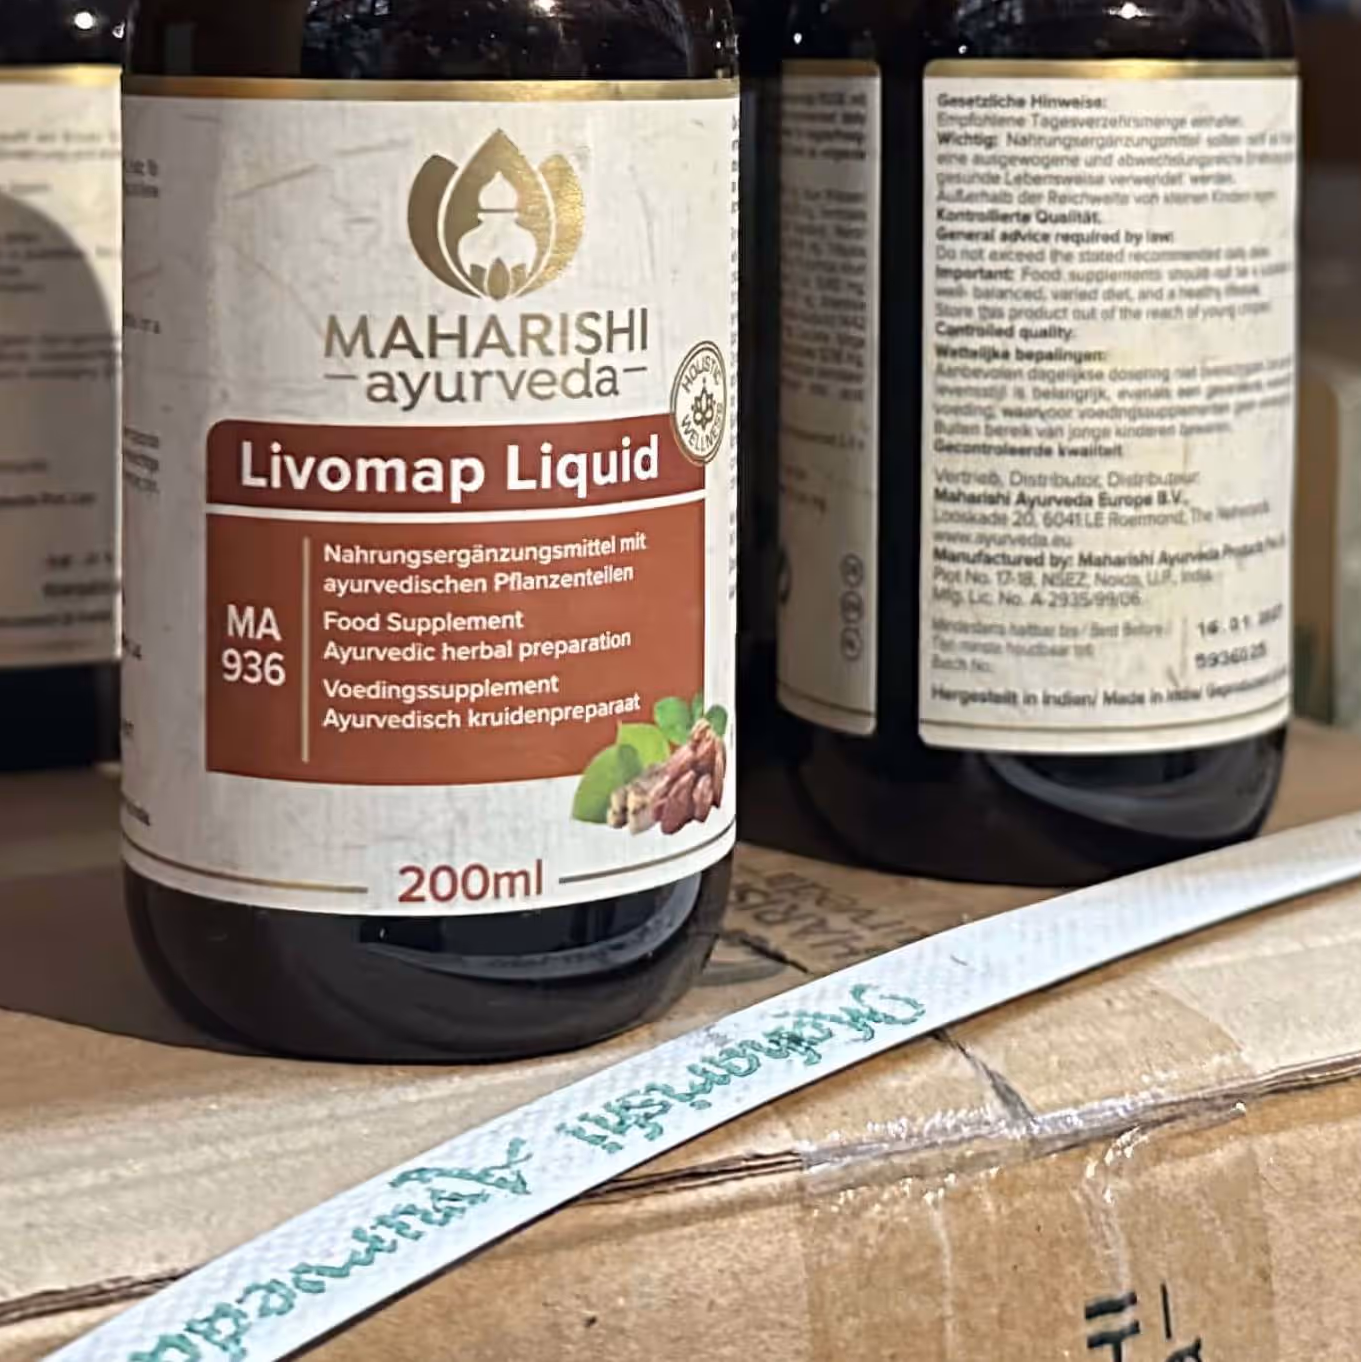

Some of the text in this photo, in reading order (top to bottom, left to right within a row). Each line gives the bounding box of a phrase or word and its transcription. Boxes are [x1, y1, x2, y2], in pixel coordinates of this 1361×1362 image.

[937, 93, 1107, 108] Gesetzliche Hinweise:
[937, 132, 999, 149] Wichtig:
[936, 209, 1031, 224] Kontrollierte
[936, 227, 995, 242] General
[1000, 229, 1050, 244] advice
[1054, 229, 1119, 247] required
[1125, 230, 1143, 246] by
[936, 246, 956, 261] Do
[960, 247, 984, 262] not
[989, 248, 1045, 262] exceed
[1050, 249, 1074, 263] the
[1079, 249, 1124, 263] stated
[1021, 267, 1061, 282] Food
[1051, 288, 1098, 302] varied
[1138, 287, 1163, 301] and
[1008, 306, 1068, 322] product
[1072, 307, 1097, 321] out
[1101, 305, 1115, 320] of
[1120, 306, 1142, 320] the
[1147, 305, 1184, 320] reach
[323, 307, 650, 361] MAHARISHI
[935, 321, 1014, 339] Controlled
[366, 358, 621, 412] ayurveda
[681, 354, 721, 393] HOLISTIC
[1036, 424, 1064, 438] van
[238, 433, 662, 503] Livomap Liquid
[934, 488, 1010, 506] Maharishi
[1015, 492, 1093, 510] Ayurveda
[1098, 493, 1152, 511] Europe
[324, 534, 647, 567] Nahrungsergänzungsmittel mit
[933, 548, 1043, 568] Manufactured
[1078, 551, 1153, 568] Maharishi
[324, 564, 634, 598] ayurvedischen Pflanzenteilen
[228, 605, 280, 641] MA
[324, 609, 524, 637] Food Supplement
[324, 630, 632, 666] Ayurvedic herbal preparation
[221, 649, 286, 687] 936
[324, 675, 559, 704] Voedingssupplement
[323, 696, 641, 733] Ayurvedisch kruidenpreparaat
[398, 861, 544, 904] 200ml
